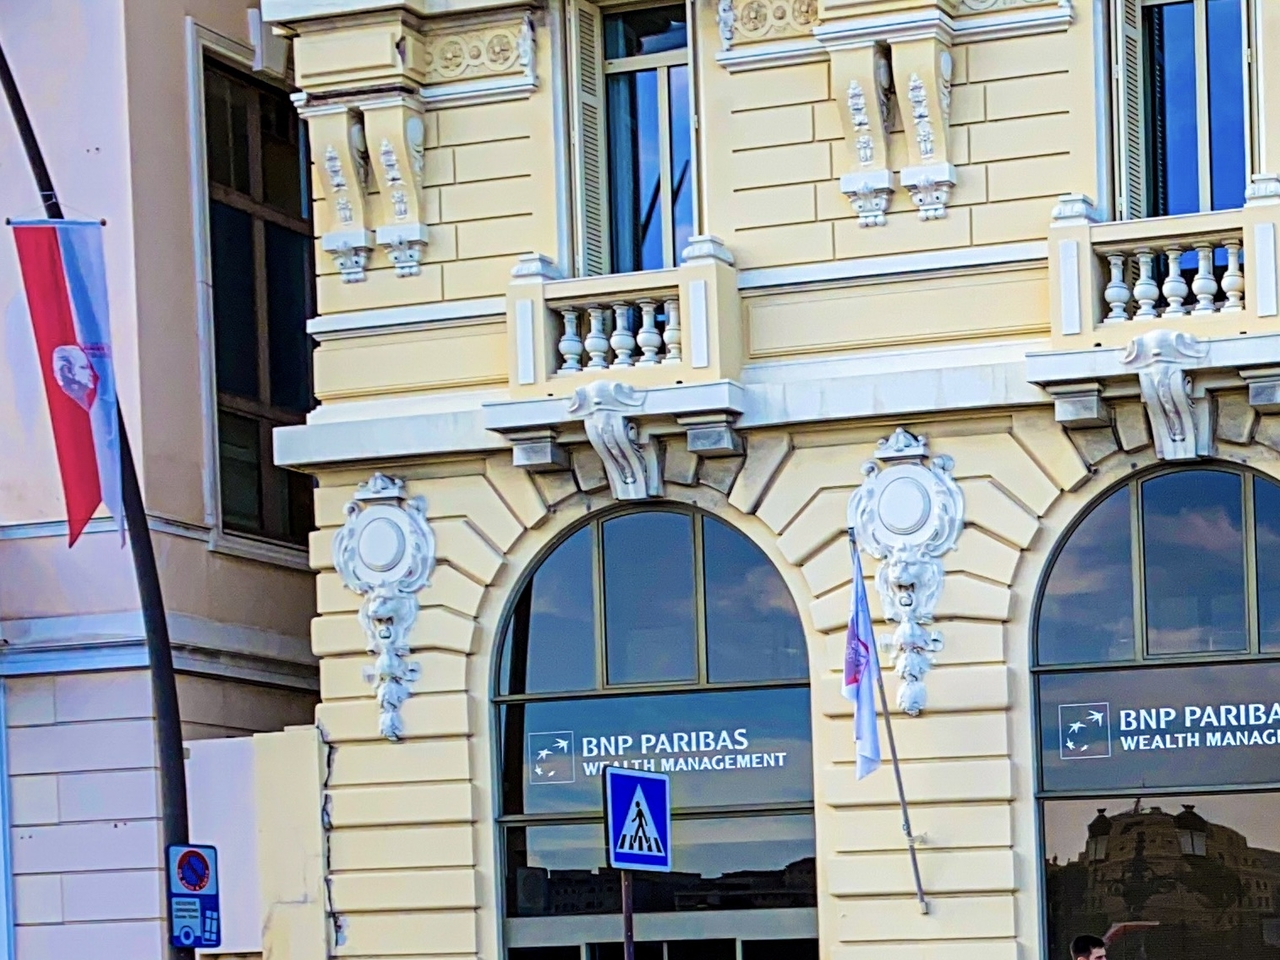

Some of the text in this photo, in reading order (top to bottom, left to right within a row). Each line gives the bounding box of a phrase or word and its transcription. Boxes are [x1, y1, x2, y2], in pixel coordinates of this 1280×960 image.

[1120, 707, 1176, 730] BNP
[582, 729, 749, 757] BNP PARIBAS
[1120, 732, 1200, 750] WEALTH
[661, 752, 787, 772] MANAGEMENT
